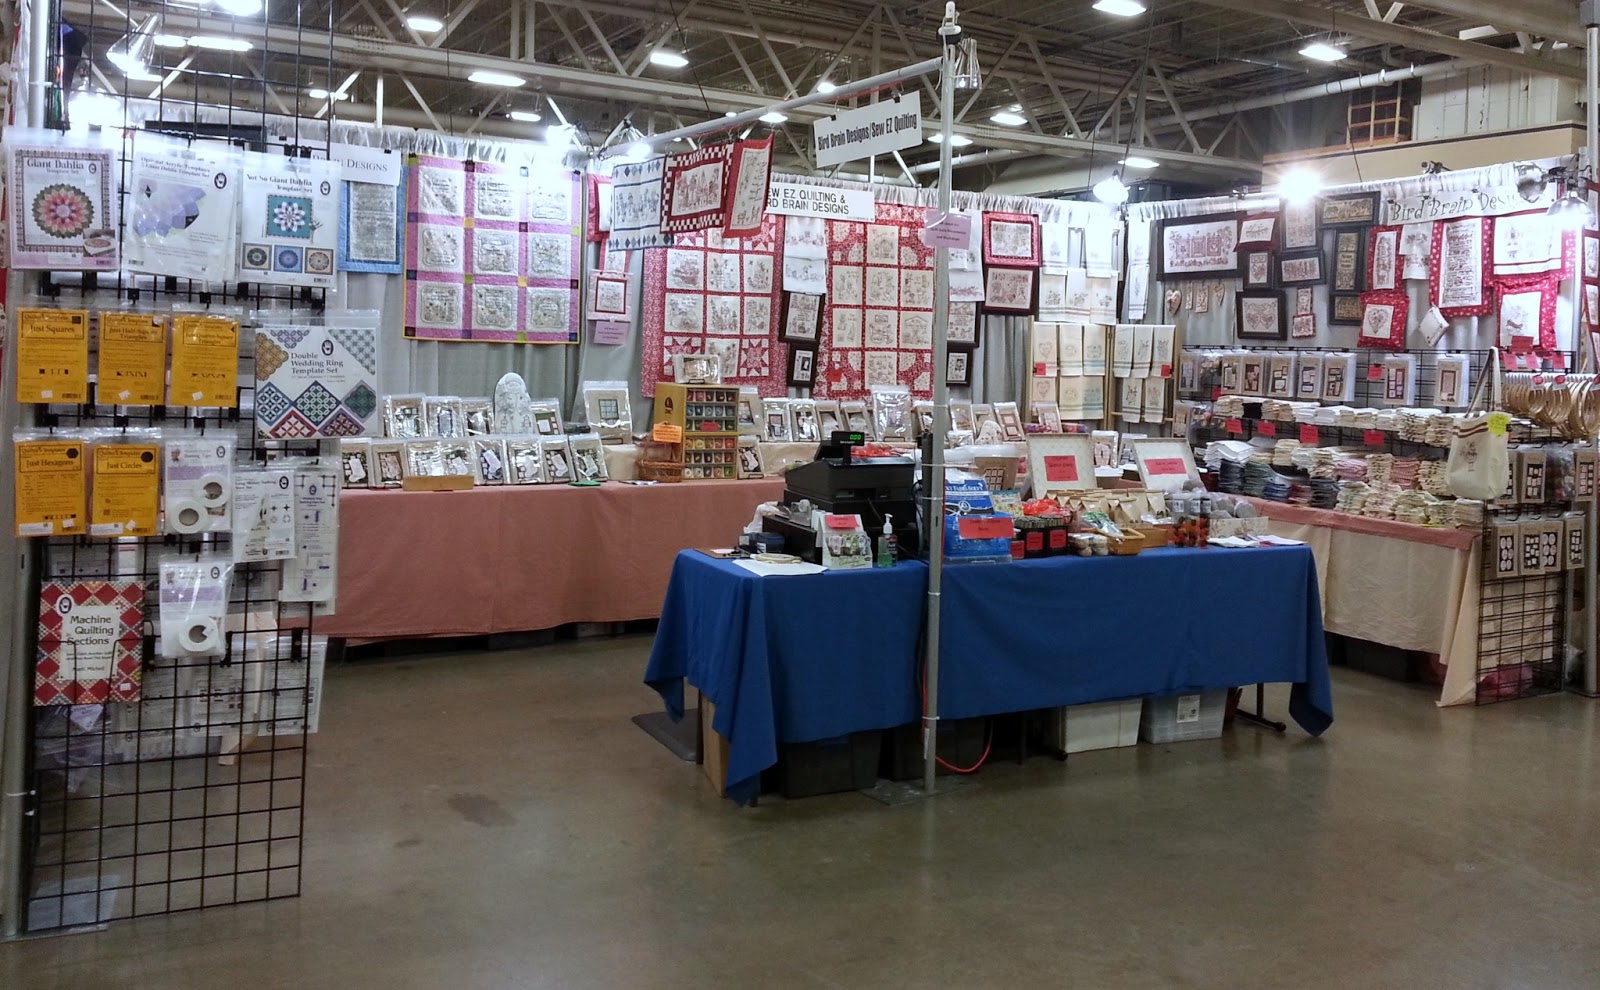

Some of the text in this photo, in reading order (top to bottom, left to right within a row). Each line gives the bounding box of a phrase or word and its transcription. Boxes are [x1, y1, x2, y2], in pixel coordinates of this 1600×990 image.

[818, 134, 830, 150] Bird
[830, 130, 846, 148] Brain
[886, 118, 893, 134] EZ
[894, 113, 917, 134] Quilting
[27, 159, 84, 169] Giant Dahlia
[347, 159, 388, 172] DESIGNS
[289, 178, 313, 186] Dahlia
[783, 188, 796, 199] EZ
[799, 190, 837, 203] QUILTING
[840, 194, 846, 203] &
[767, 198, 849, 214] RD BRAIN DESIGNS
[1391, 200, 1425, 221] Bird
[1428, 196, 1473, 217] Brain
[46, 325, 75, 334] Squares
[26, 460, 74, 469] Just Hexagons
[107, 462, 120, 470] Just
[70, 615, 112, 624] Machine
[75, 626, 114, 636] Quilting
[67, 637, 109, 646] Sections
